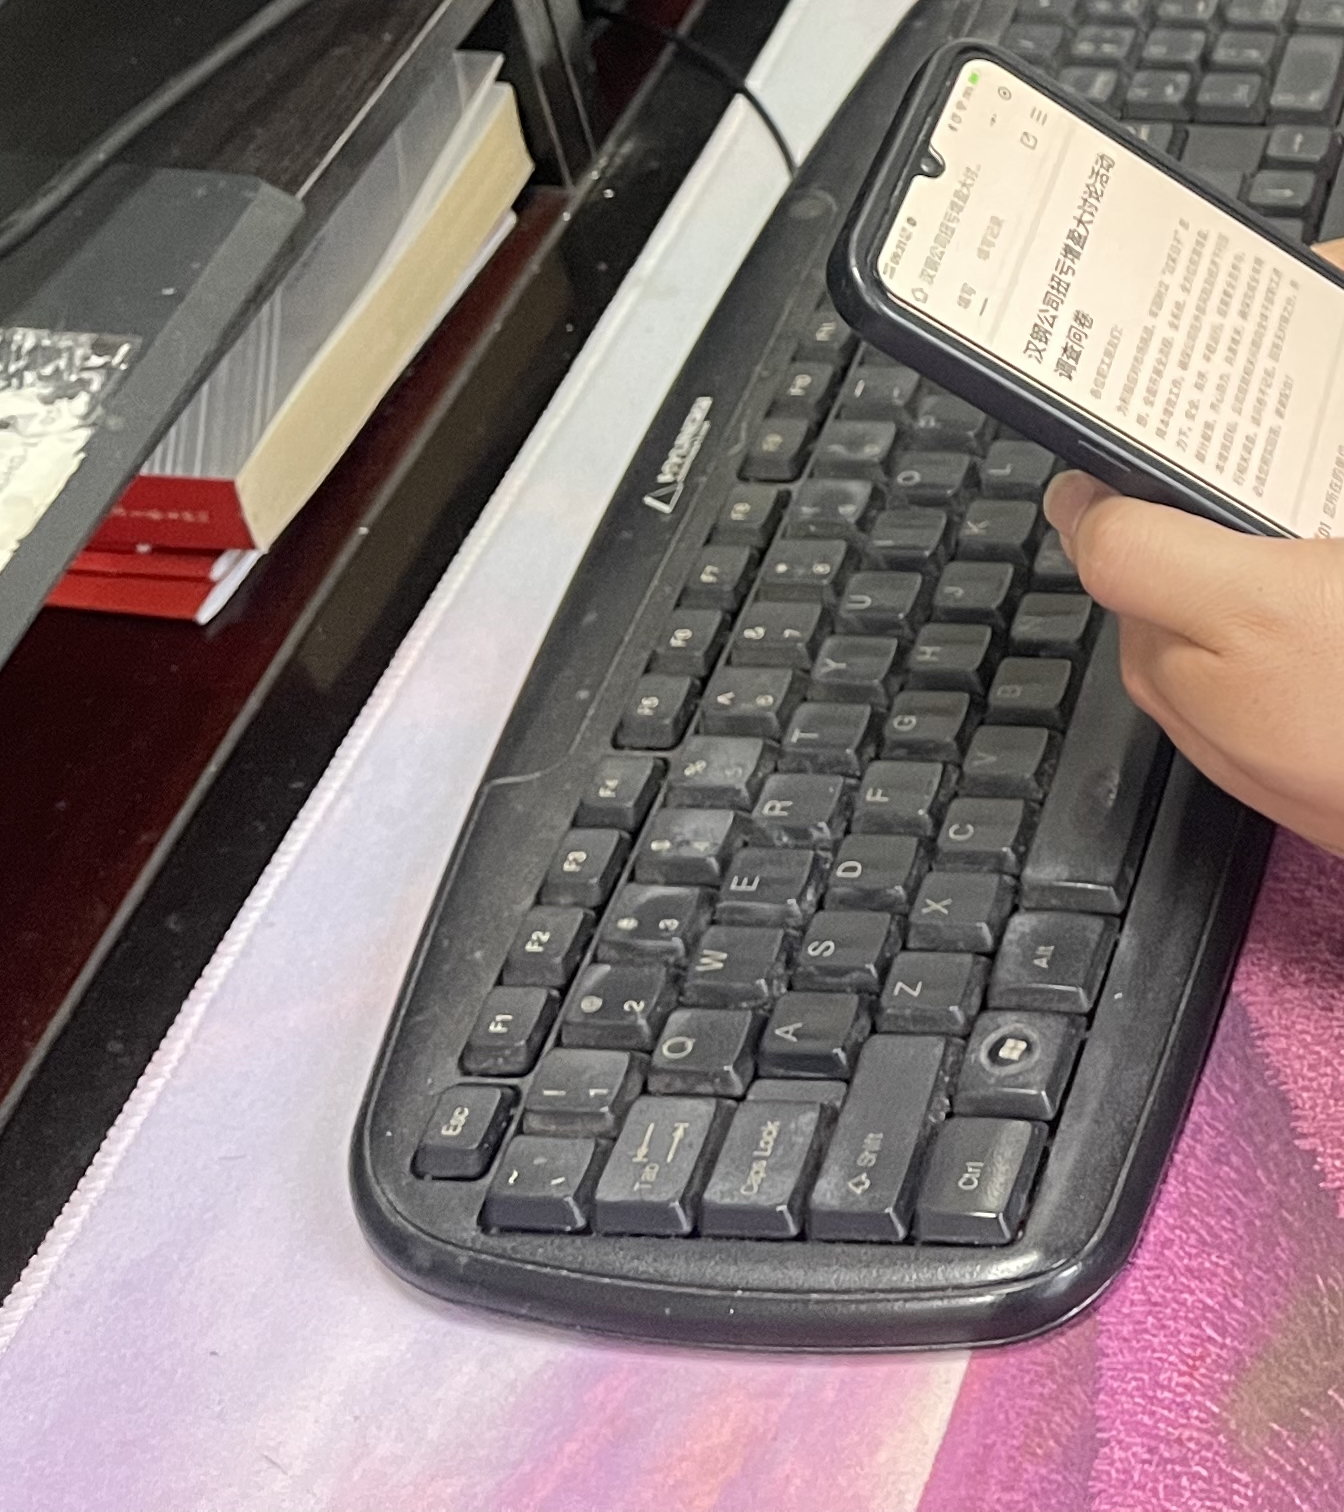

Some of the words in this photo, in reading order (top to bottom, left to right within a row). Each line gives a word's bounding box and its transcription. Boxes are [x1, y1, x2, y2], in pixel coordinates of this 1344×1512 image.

[1023, 153, 1116, 364] 汉钢公司扭亏增盈大讨论活动
[1054, 310, 1094, 381] 调查问卷
[897, 470, 921, 485] O
[989, 463, 1012, 475] L
[965, 521, 988, 534] K
[944, 586, 964, 598] J
[846, 595, 872, 609] U
[917, 646, 942, 661] H
[820, 658, 846, 674] Y
[893, 715, 917, 731] G
[790, 727, 819, 743] T
[865, 788, 889, 802] F
[761, 800, 793, 816] R
[948, 824, 974, 841] C
[835, 861, 862, 878] D
[729, 875, 760, 891] E
[921, 898, 952, 915] X
[525, 931, 550, 952] F2
[807, 940, 835, 957] S
[695, 949, 728, 971] W
[1033, 946, 1054, 968] Alt
[893, 981, 922, 997] Z
[623, 1000, 645, 1015] 2
[489, 1015, 513, 1033] F1
[774, 1022, 803, 1042] A
[662, 1031, 695, 1059] Q
[441, 1107, 469, 1136] Esc
[736, 1160, 767, 1199] Caps
[753, 1121, 780, 1156] Lock
[633, 1159, 659, 1192] Tab
[958, 1162, 984, 1190] Ctrl
